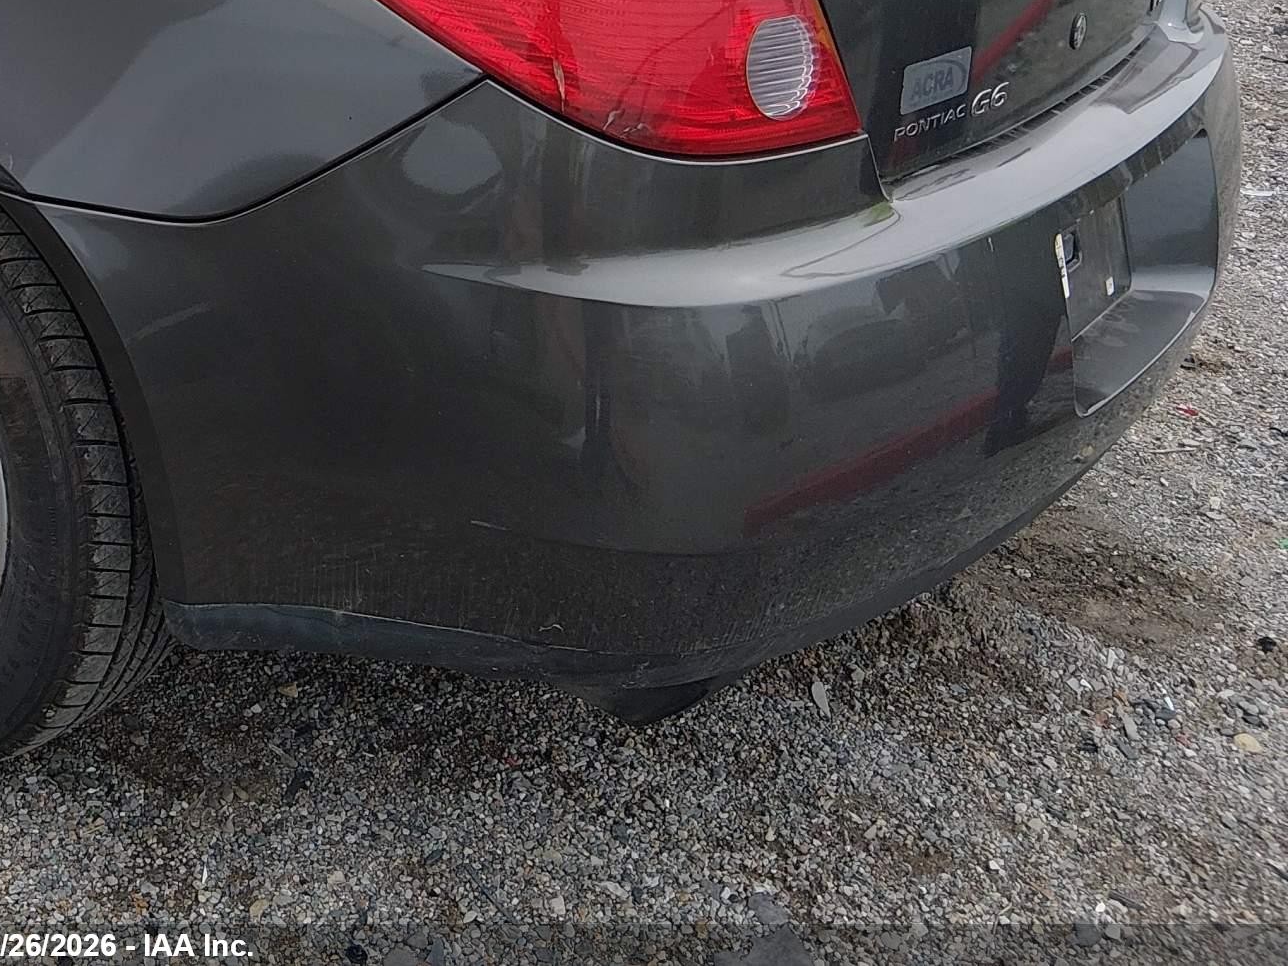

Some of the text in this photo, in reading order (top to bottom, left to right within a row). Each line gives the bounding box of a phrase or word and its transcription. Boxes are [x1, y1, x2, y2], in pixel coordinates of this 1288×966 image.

[909, 67, 953, 100] ACRA
[894, 81, 1010, 142] PONTIAC G6
